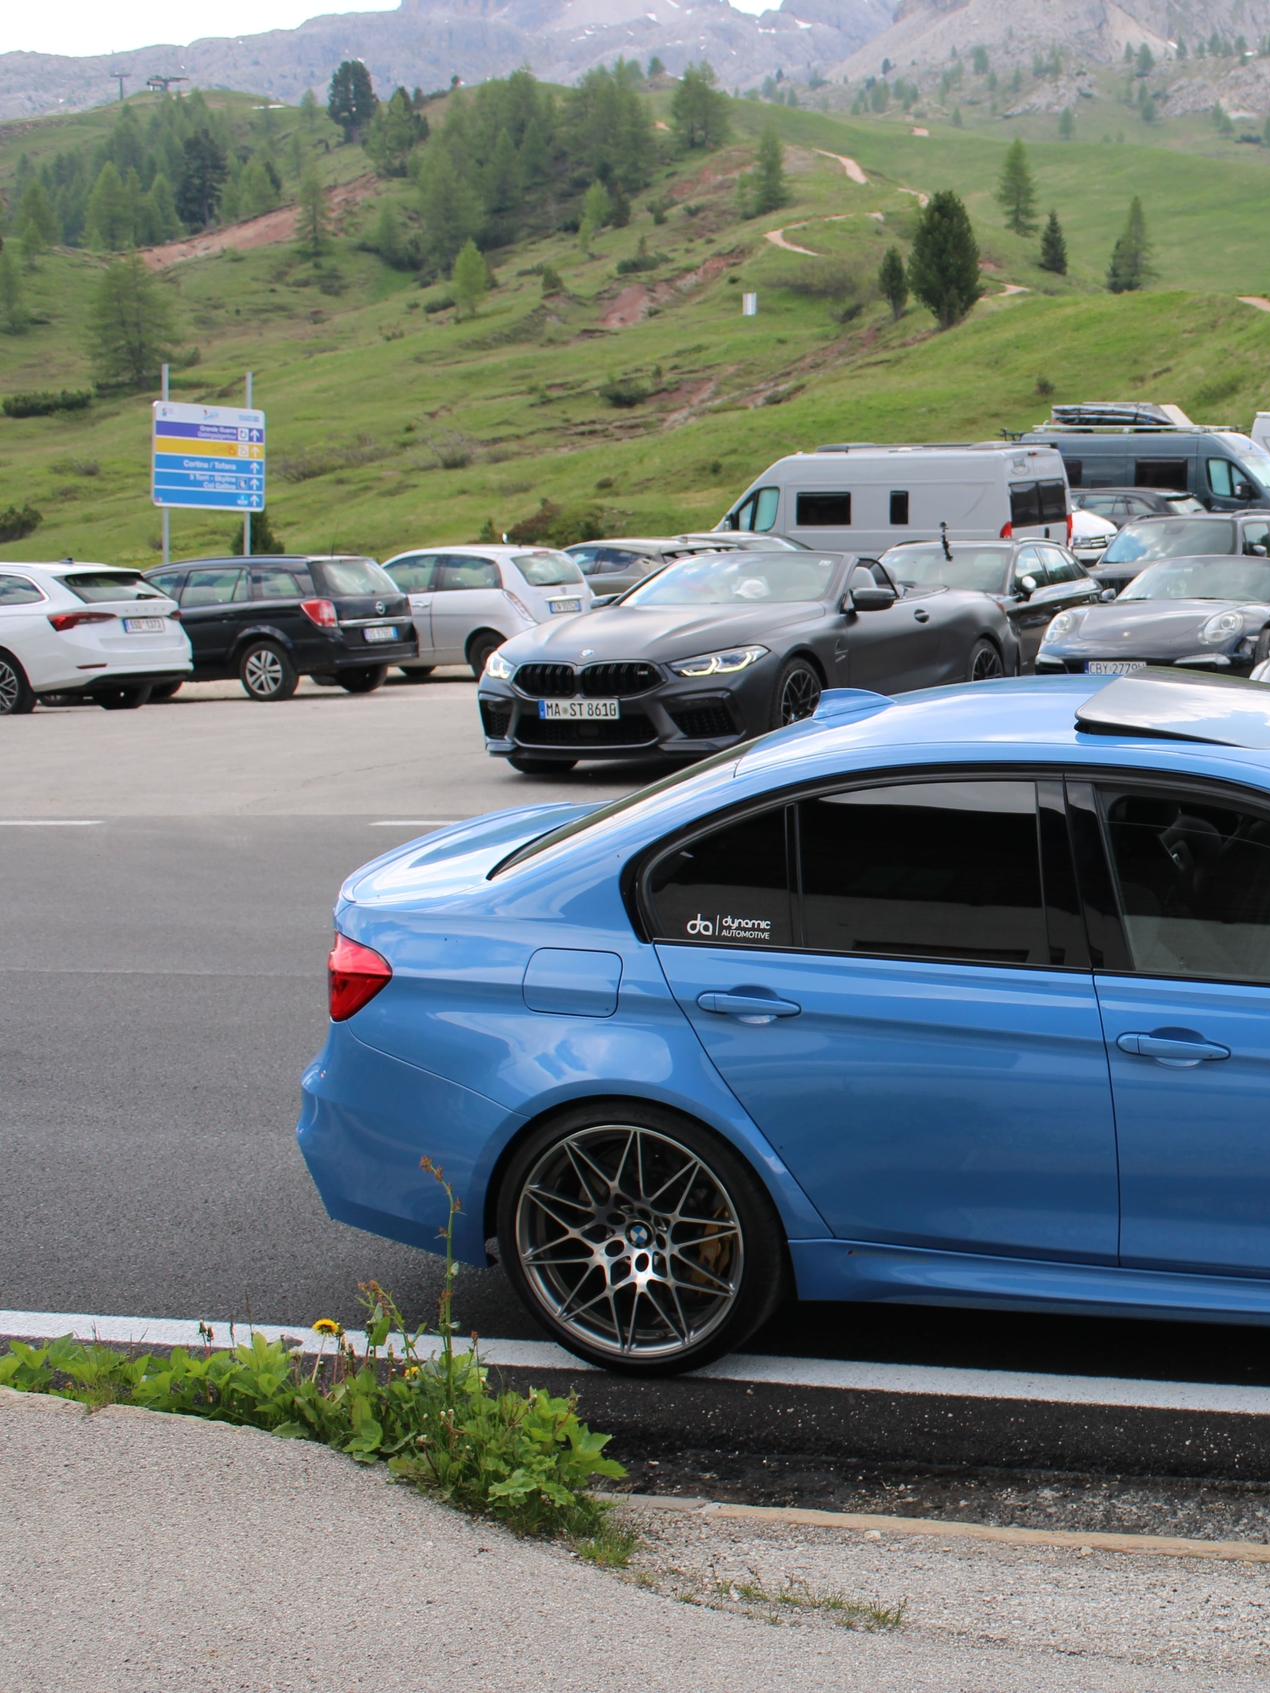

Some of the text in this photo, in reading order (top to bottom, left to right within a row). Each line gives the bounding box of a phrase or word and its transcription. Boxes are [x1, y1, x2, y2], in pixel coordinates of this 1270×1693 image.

[183, 460, 208, 468] Cortina
[214, 462, 236, 470] Tofana
[1089, 663, 1108, 674] CBY
[546, 703, 616, 717] MA ST 8610
[722, 916, 771, 930] dynamic
[721, 929, 770, 940] AUTOMOTIVE
